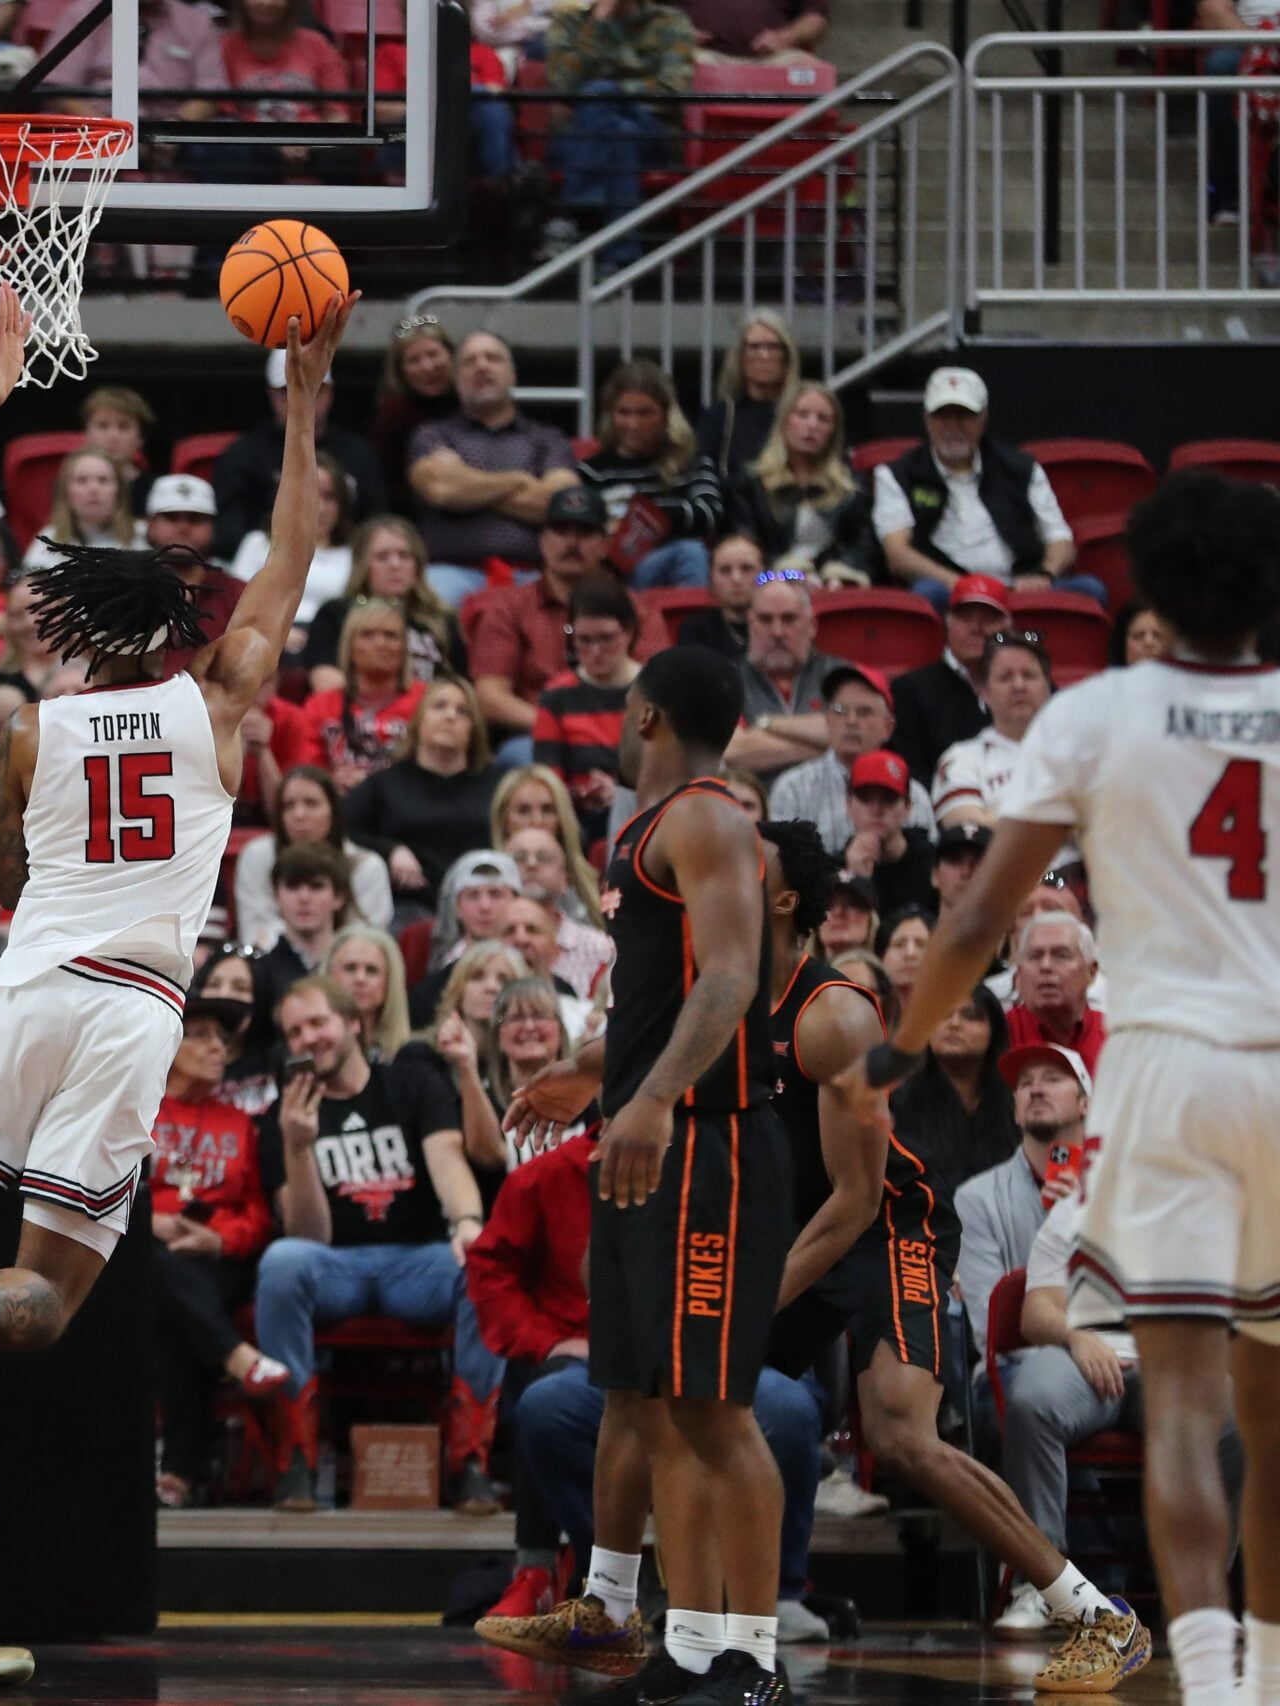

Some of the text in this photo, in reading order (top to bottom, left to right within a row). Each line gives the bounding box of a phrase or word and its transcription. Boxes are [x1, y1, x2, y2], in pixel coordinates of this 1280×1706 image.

[89, 712, 162, 743] TOPPIN
[84, 751, 176, 863] 15
[1187, 755, 1267, 903] 4
[687, 1231, 726, 1318] POKES
[899, 1238, 932, 1305] POKES
